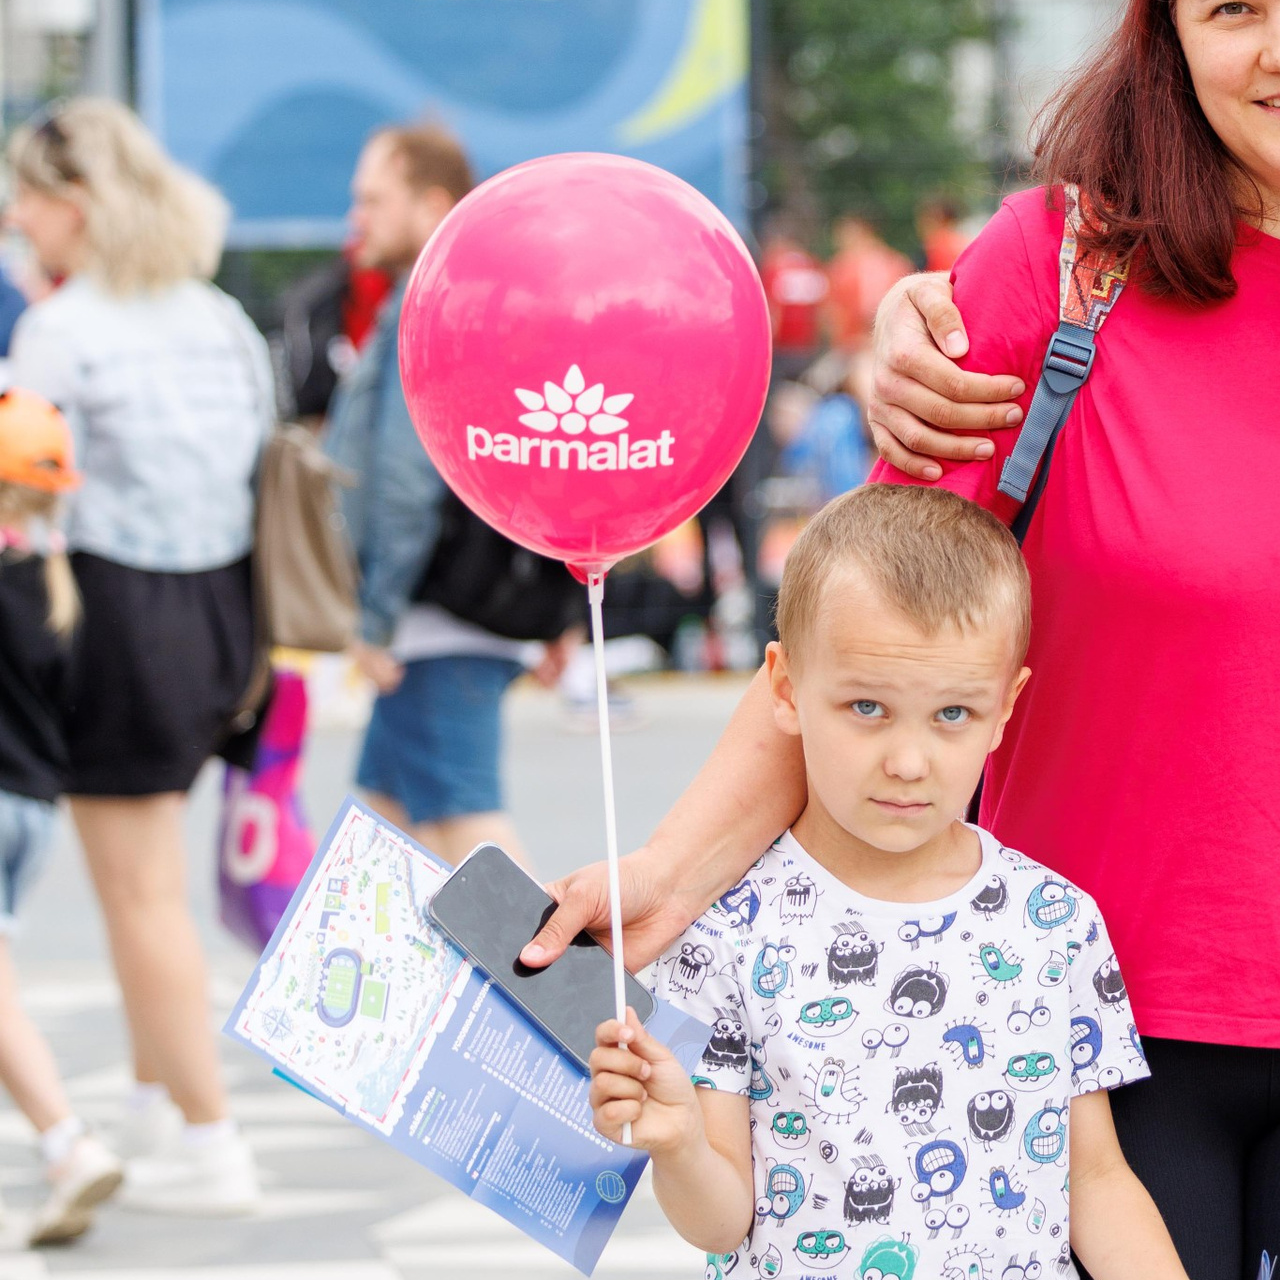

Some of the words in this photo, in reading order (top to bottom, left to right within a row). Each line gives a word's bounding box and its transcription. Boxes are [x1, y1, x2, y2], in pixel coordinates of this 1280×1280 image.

[466, 424, 676, 473] parmalat
[471, 981, 490, 1012] ОБОЗНА
[786, 1032, 826, 1051] AWESOME
